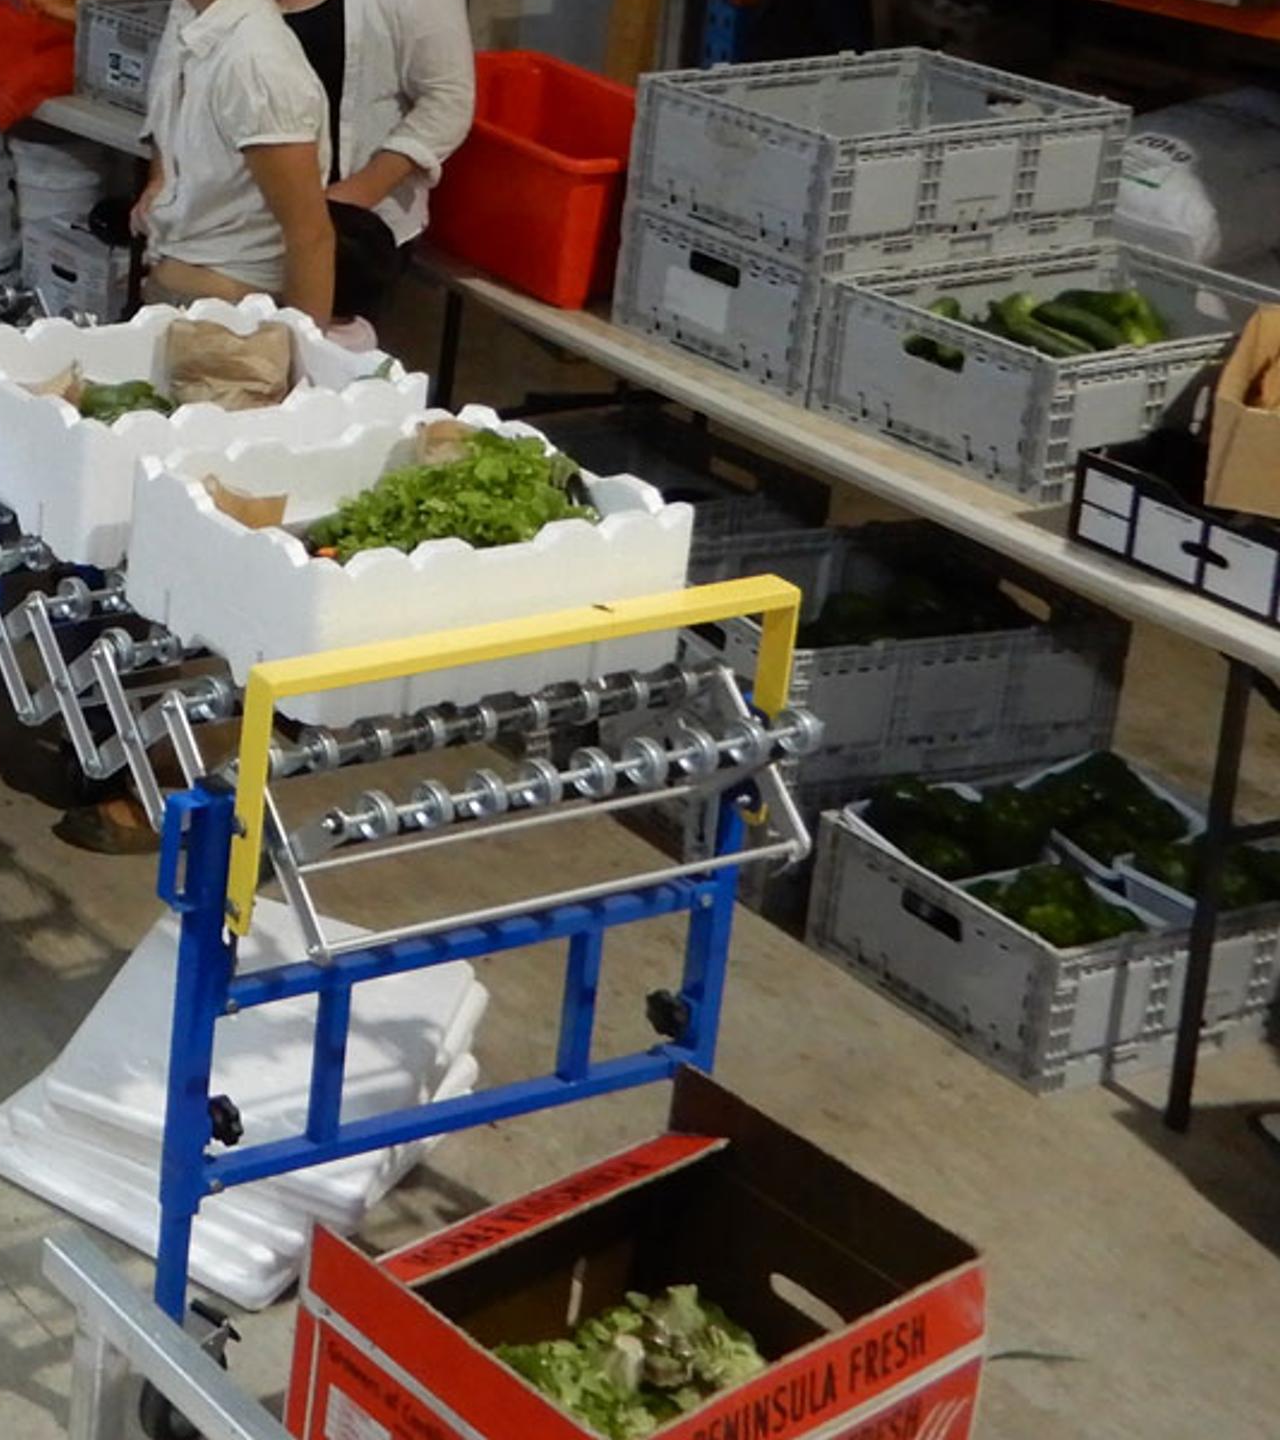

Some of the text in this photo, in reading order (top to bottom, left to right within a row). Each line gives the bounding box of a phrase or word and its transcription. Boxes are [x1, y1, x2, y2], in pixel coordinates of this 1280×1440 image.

[1135, 135, 1193, 163] 20kg
[693, 1361, 837, 1440] NINSULA
[848, 1312, 926, 1394] FRESH
